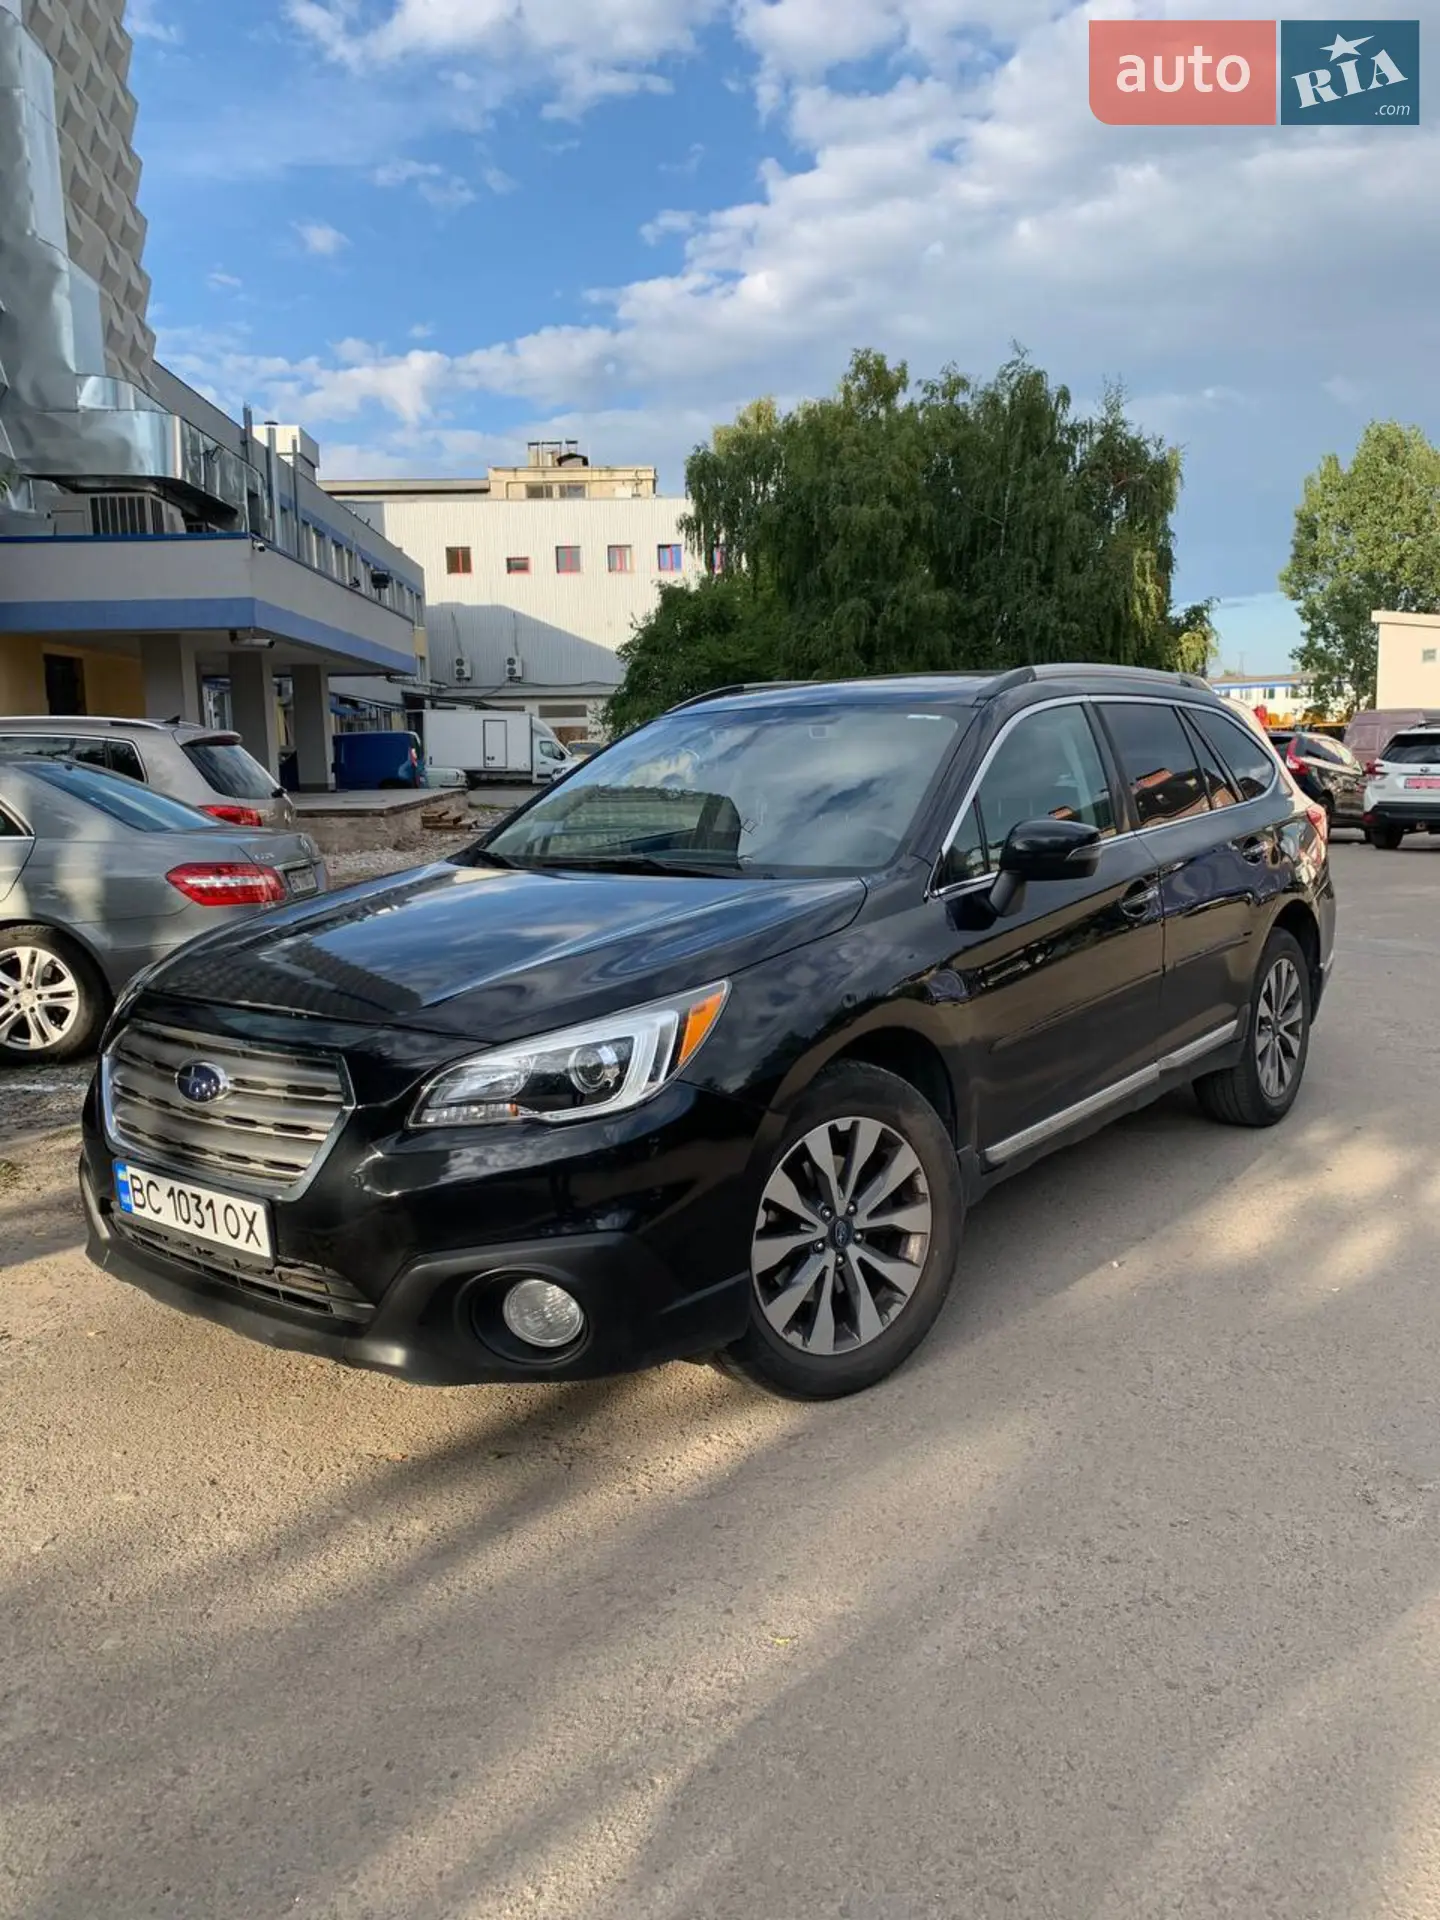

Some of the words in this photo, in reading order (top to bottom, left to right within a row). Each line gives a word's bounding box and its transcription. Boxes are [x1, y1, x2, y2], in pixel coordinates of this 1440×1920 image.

[129, 1173, 163, 1215] BC
[166, 1186, 218, 1235] 1031
[223, 1203, 262, 1248] OX
